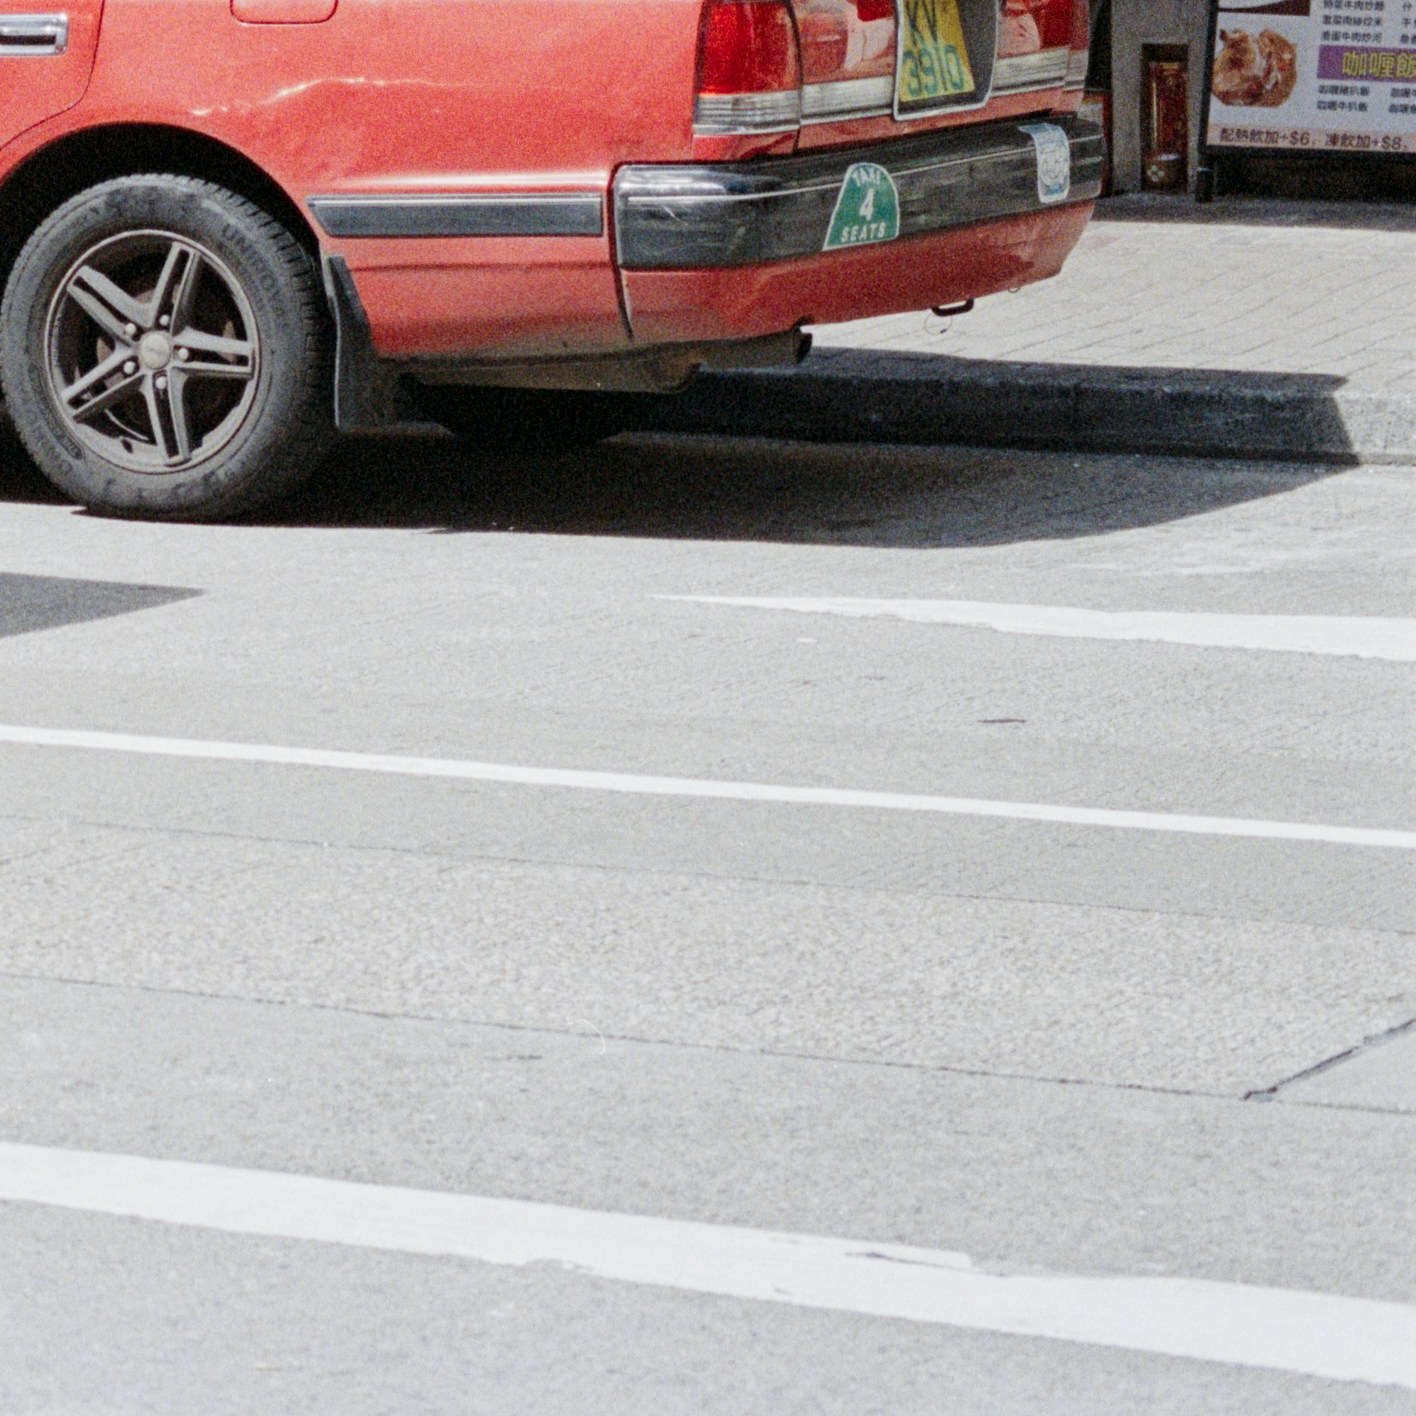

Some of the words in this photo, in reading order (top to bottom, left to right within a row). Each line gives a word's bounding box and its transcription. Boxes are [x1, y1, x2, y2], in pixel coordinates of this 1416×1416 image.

[851, 167, 881, 187] TAXI
[859, 188, 876, 221] 4
[839, 221, 887, 244] SEATS
